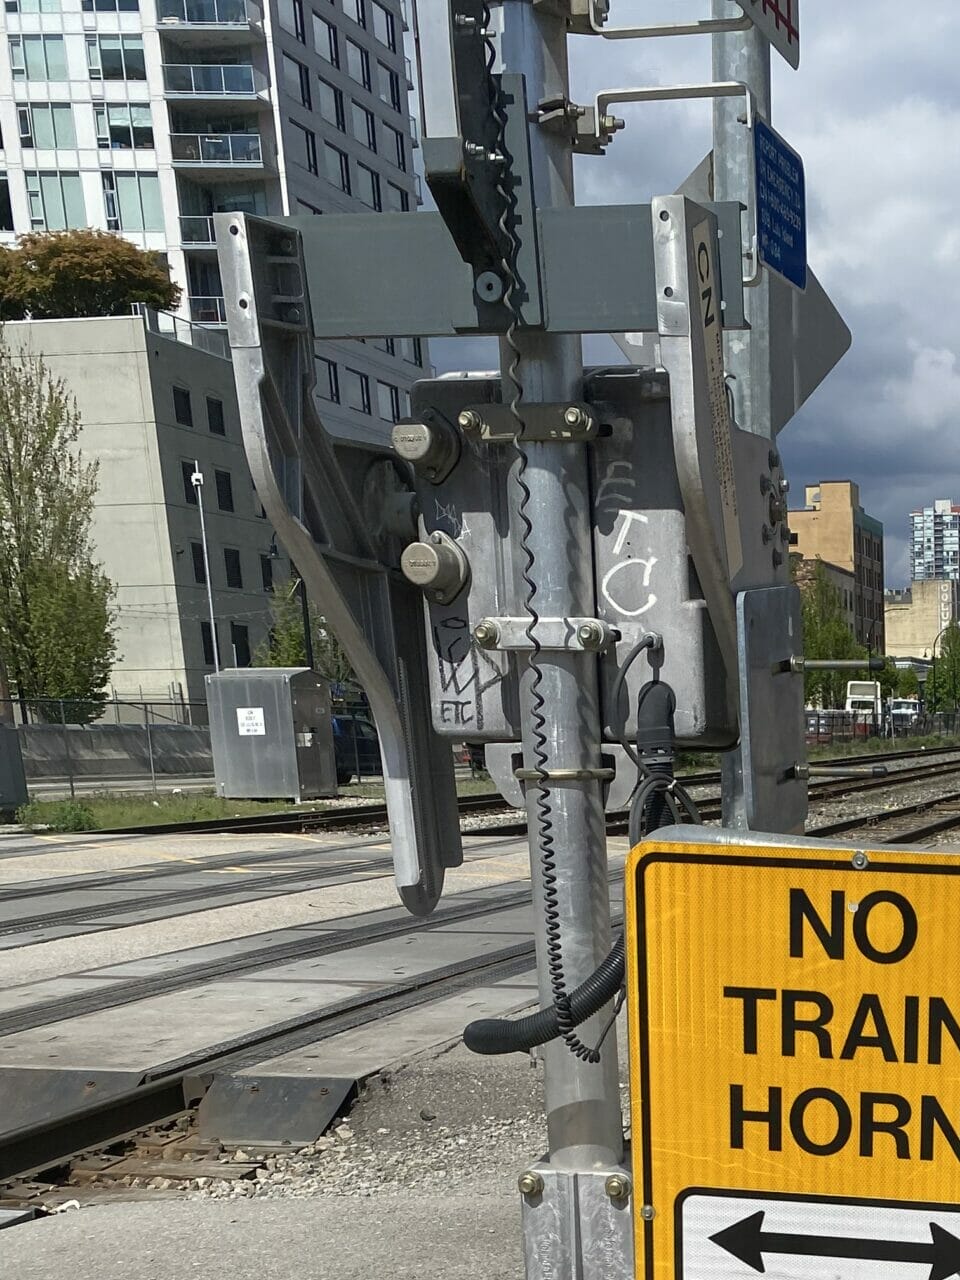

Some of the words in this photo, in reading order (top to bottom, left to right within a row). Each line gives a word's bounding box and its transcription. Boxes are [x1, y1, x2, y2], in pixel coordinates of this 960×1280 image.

[698, 242, 715, 328] CN
[440, 700, 474, 725] ETC
[788, 888, 918, 965] NO
